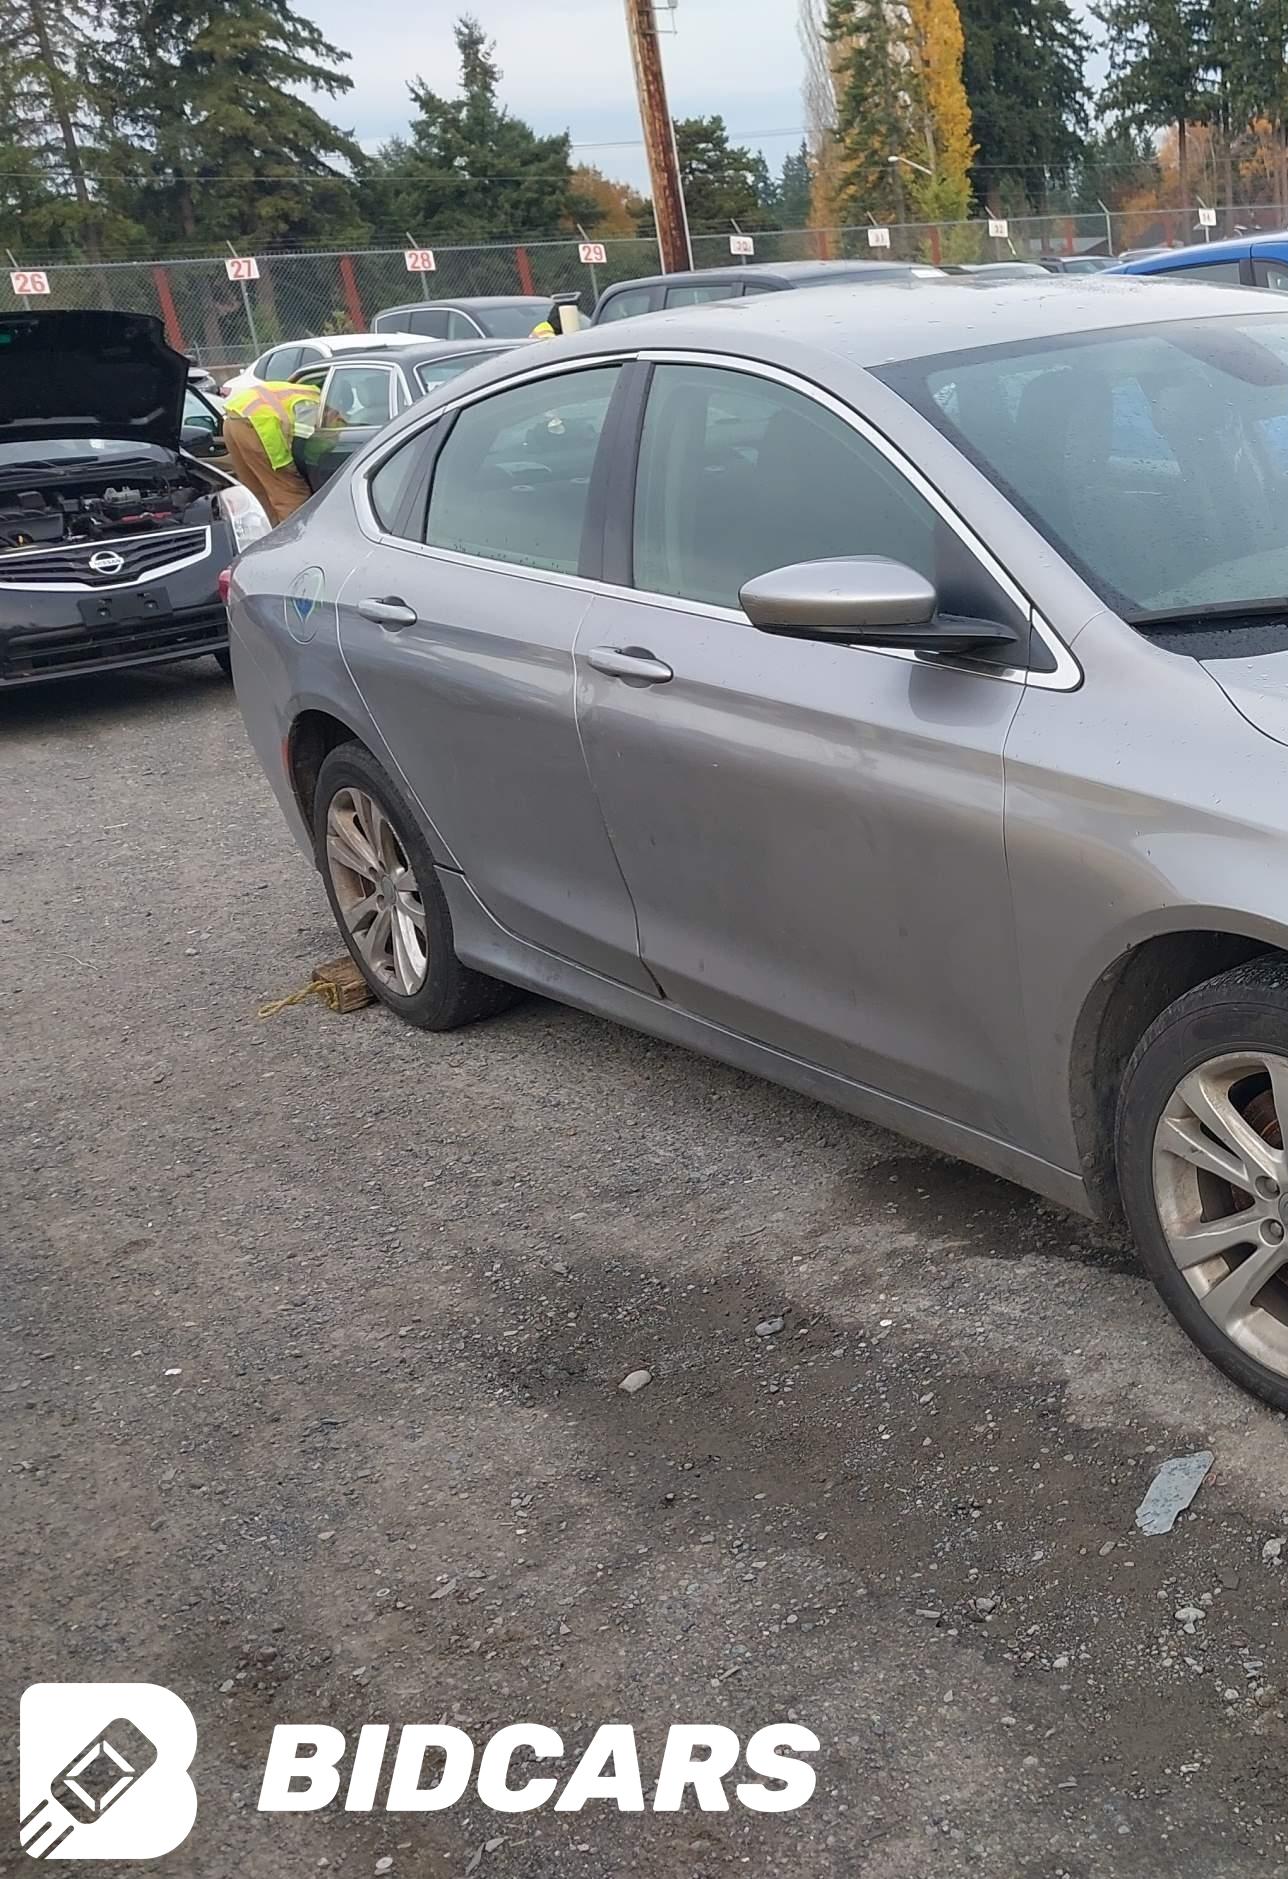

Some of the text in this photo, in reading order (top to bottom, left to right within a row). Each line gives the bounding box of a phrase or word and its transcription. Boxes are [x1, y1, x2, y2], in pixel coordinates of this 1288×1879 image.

[408, 252, 432, 270] 28
[582, 246, 604, 261] 29
[229, 260, 252, 279] 27
[14, 273, 46, 293] 26
[94, 558, 121, 567] NISSAN
